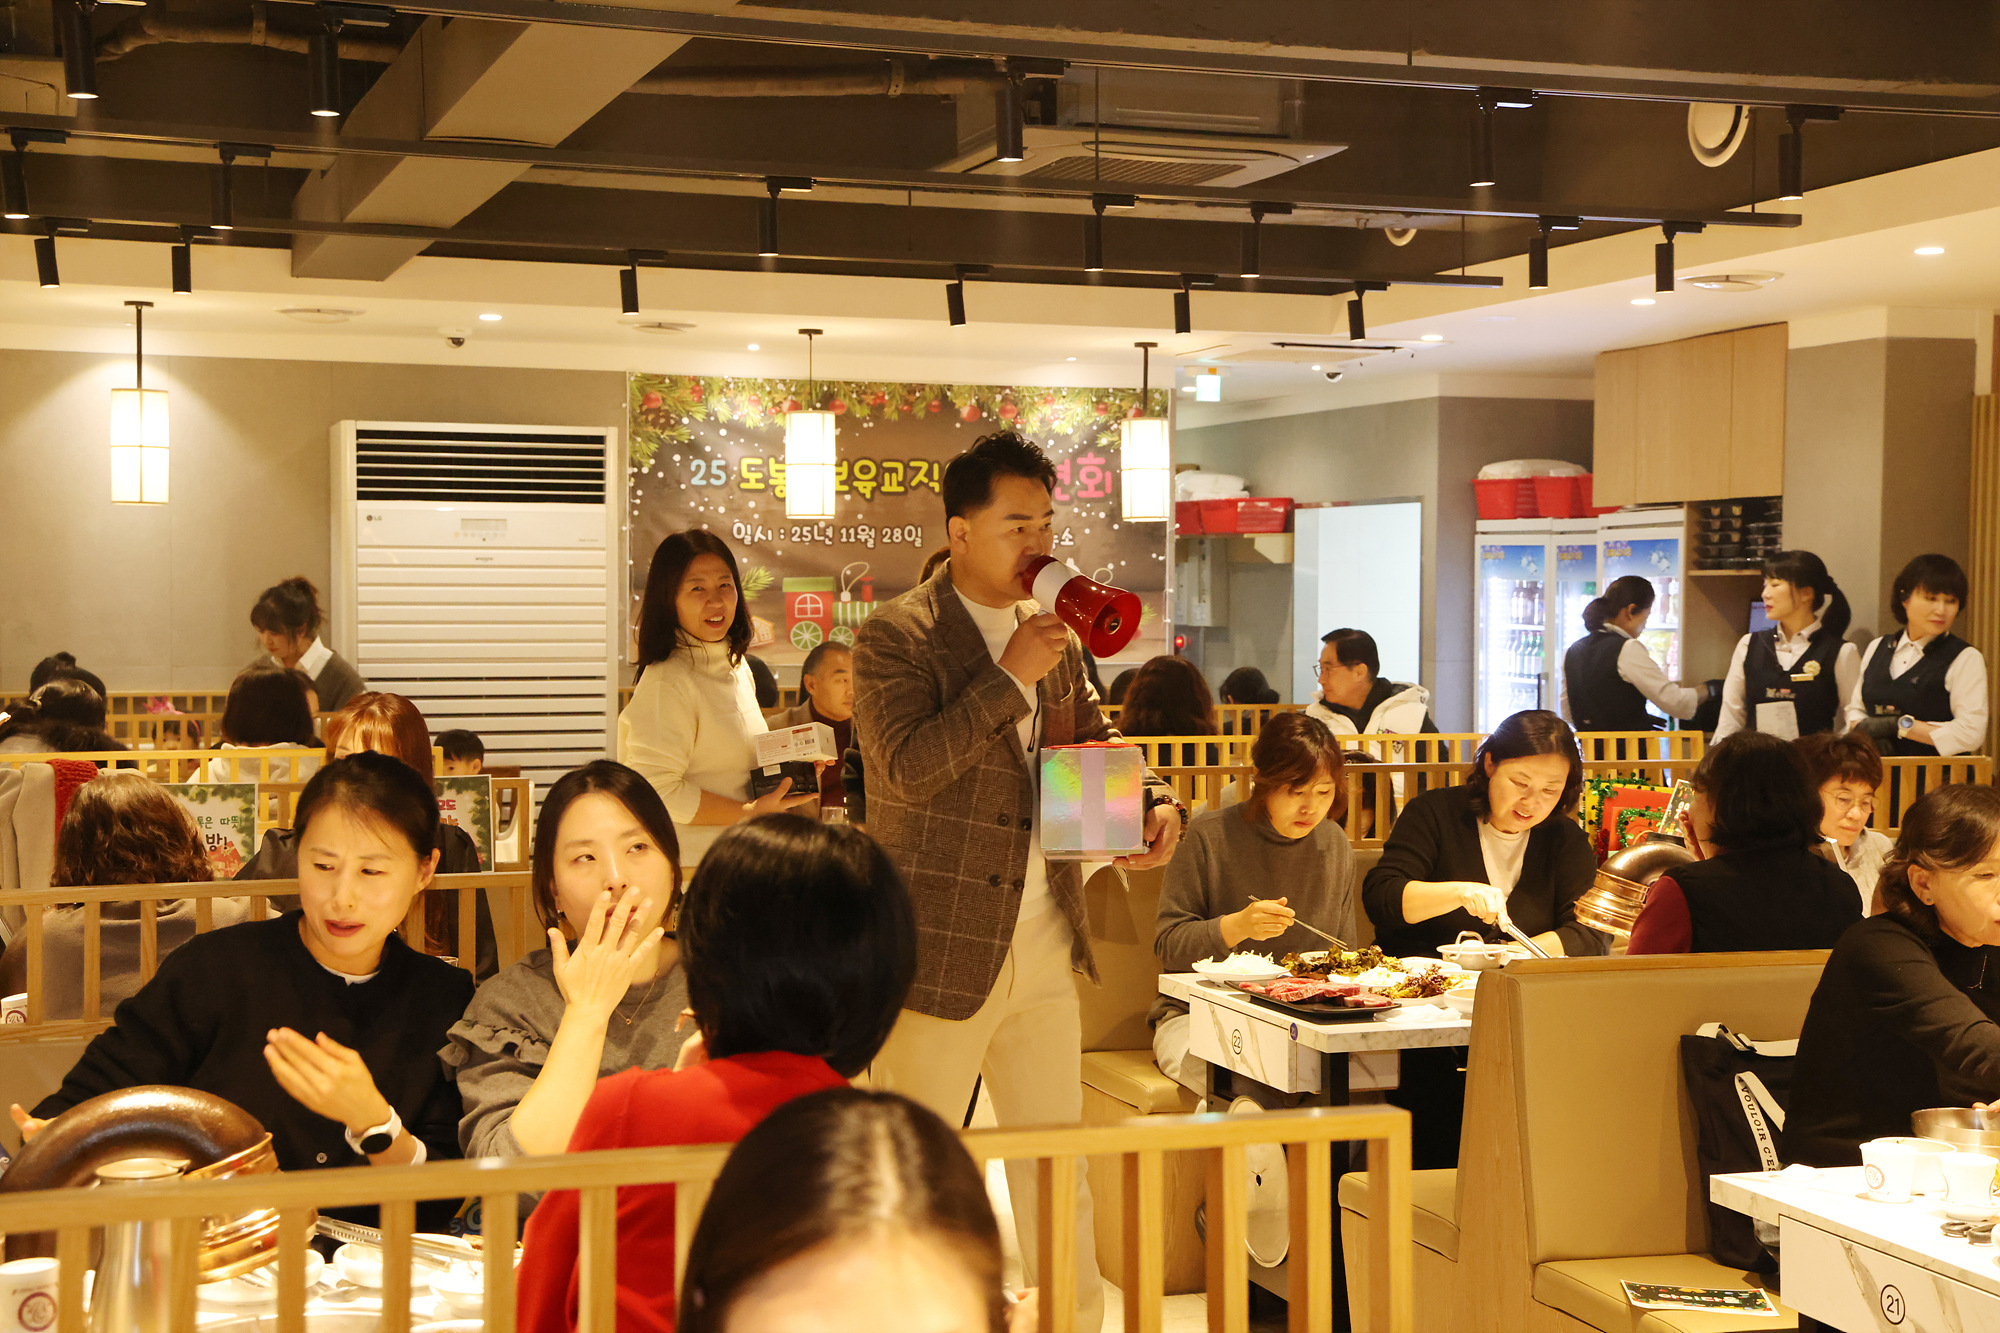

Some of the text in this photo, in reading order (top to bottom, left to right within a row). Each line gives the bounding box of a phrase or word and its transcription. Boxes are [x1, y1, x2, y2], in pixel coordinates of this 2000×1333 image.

[690, 458, 727, 486] 25
[733, 522, 773, 545] 일시
[791, 525, 833, 545] 25년
[840, 525, 875, 548] 11월
[882, 526, 922, 547] 28일
[205, 833, 227, 852] 방!
[1741, 1086, 1767, 1142] VOULOIR
[1886, 1294, 1900, 1316] 21
